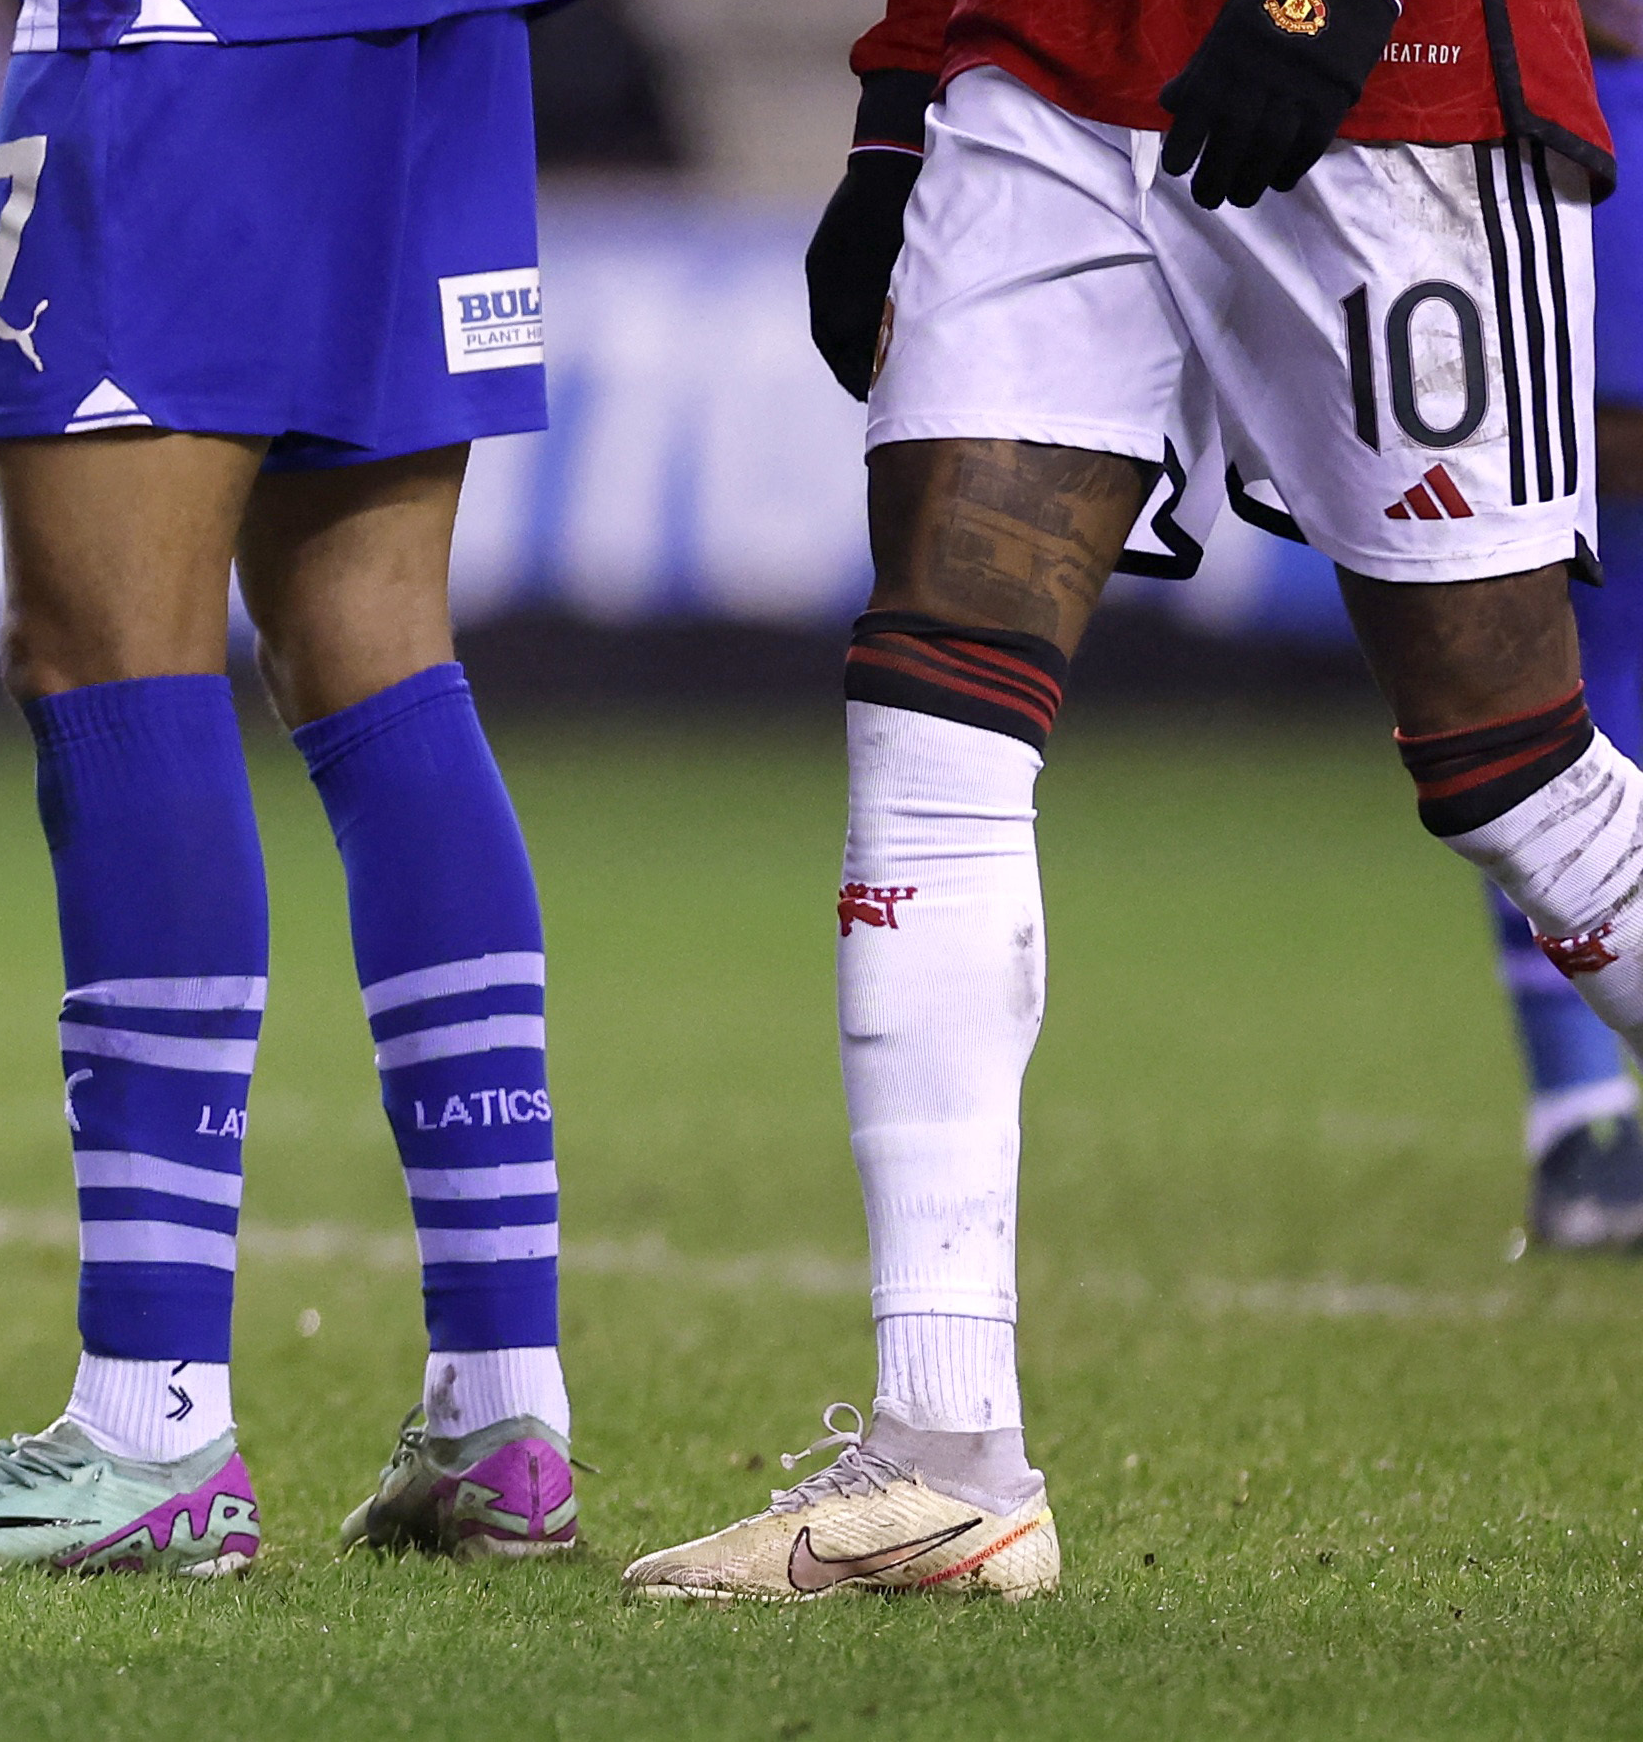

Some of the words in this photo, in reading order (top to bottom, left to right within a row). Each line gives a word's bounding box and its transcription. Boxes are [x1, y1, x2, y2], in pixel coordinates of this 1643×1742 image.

[457, 286, 542, 324] BUL
[467, 329, 520, 347] PLANT
[1340, 278, 1491, 456] 10
[195, 1104, 247, 1140] LAT
[415, 1089, 553, 1130] LATICS
[995, 1536, 1014, 1551] CAN
